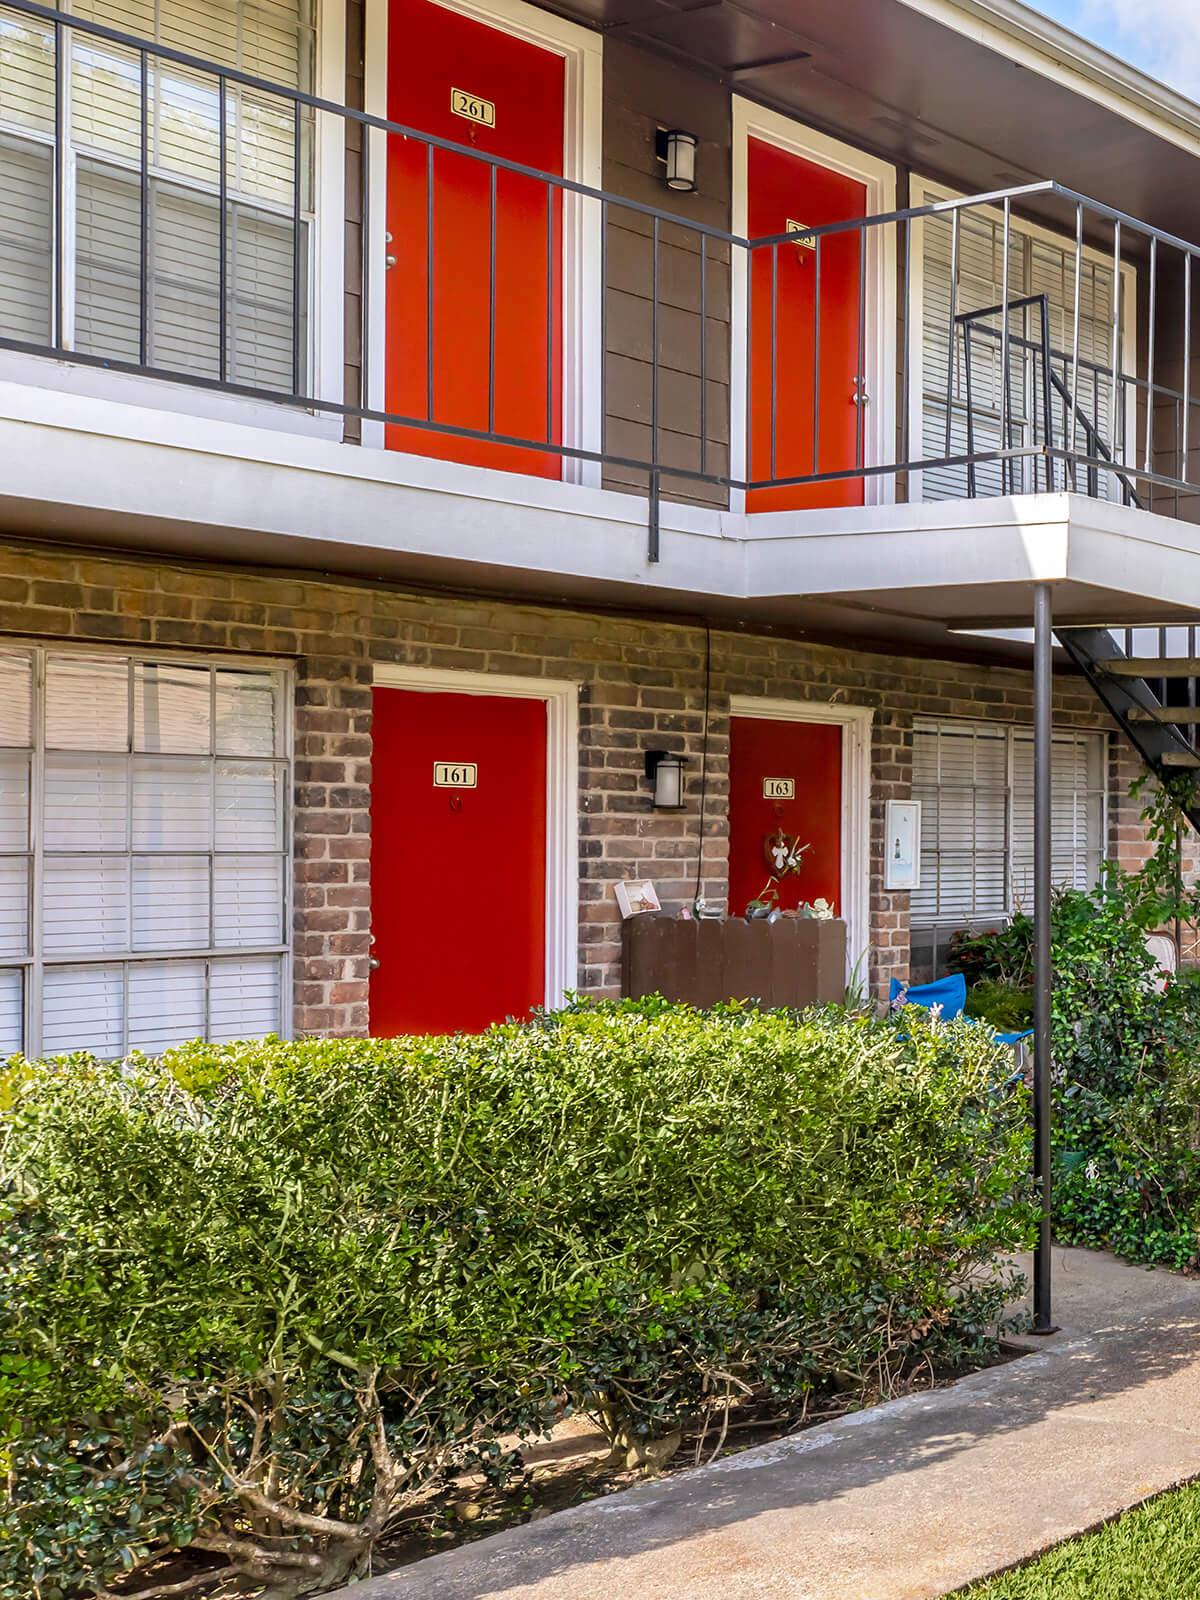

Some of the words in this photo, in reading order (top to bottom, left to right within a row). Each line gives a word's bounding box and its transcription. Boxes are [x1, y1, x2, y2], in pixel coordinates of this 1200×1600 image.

[460, 97, 485, 119] 261
[444, 767, 467, 783] 161
[771, 782, 789, 795] 163
